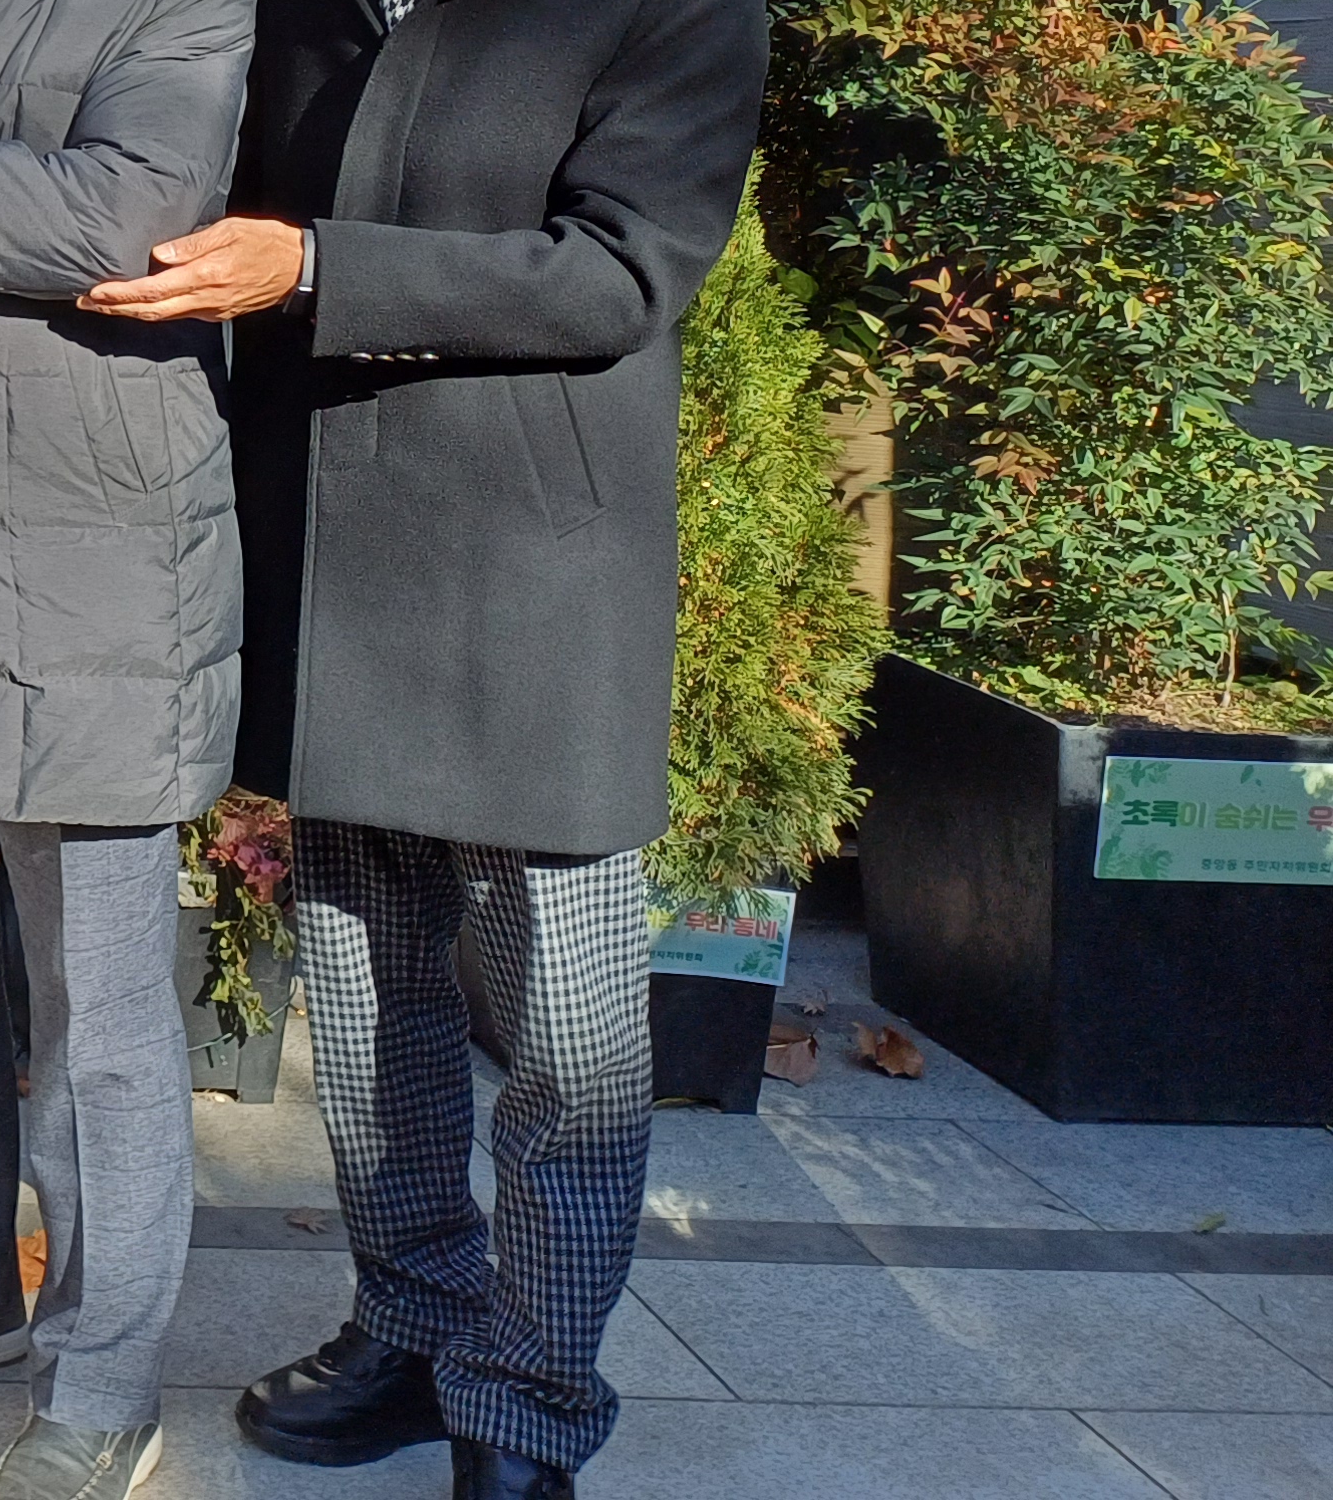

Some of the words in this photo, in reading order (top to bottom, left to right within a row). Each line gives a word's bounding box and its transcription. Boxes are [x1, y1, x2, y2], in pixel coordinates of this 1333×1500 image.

[1120, 799, 1208, 829] 초록이
[1213, 802, 1300, 831] 숨쉬는
[1200, 858, 1238, 871] 중앙동
[733, 916, 779, 941] 동네
